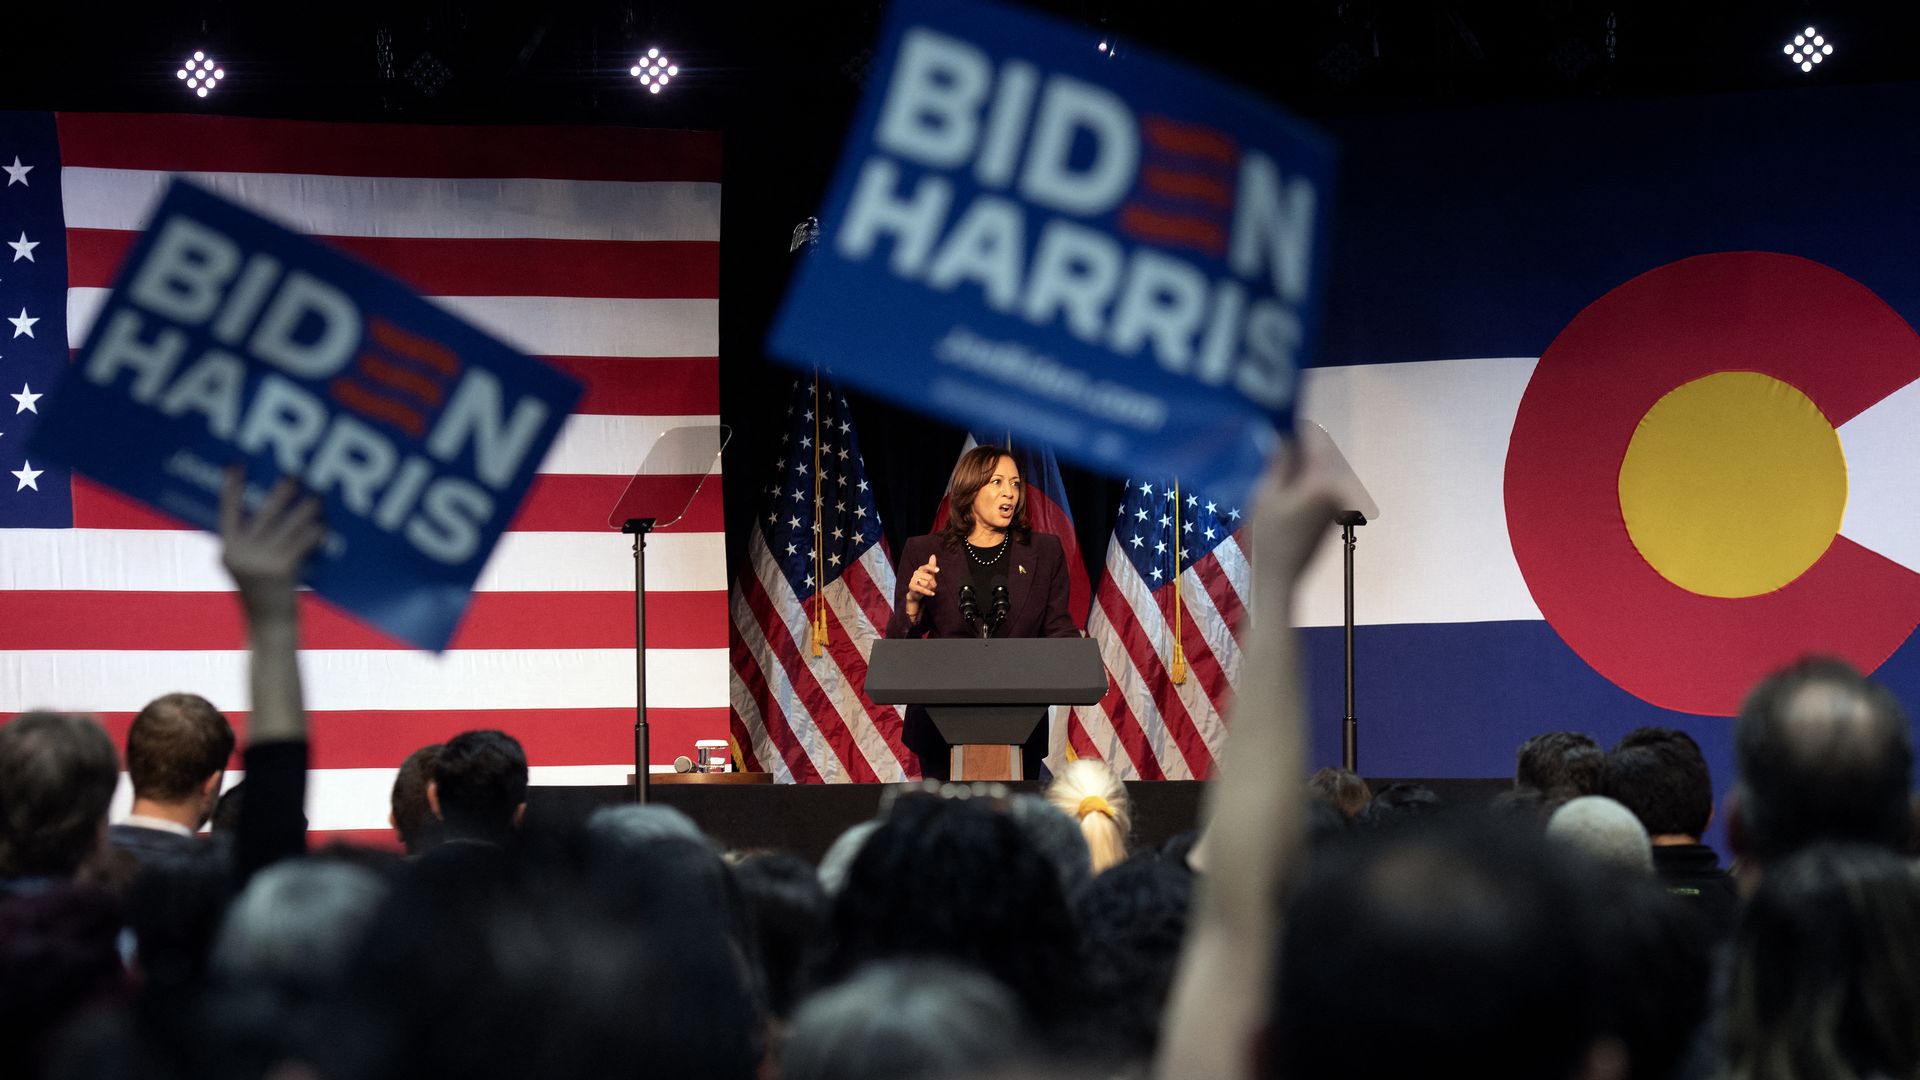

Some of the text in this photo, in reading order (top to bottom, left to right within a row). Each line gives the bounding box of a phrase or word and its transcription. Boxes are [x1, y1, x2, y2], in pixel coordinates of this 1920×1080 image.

[838, 157, 1301, 406] HARRIS
[875, 28, 1316, 298] BIDEN
[86, 311, 496, 564] HARRIS
[130, 216, 548, 489] BIDEN
